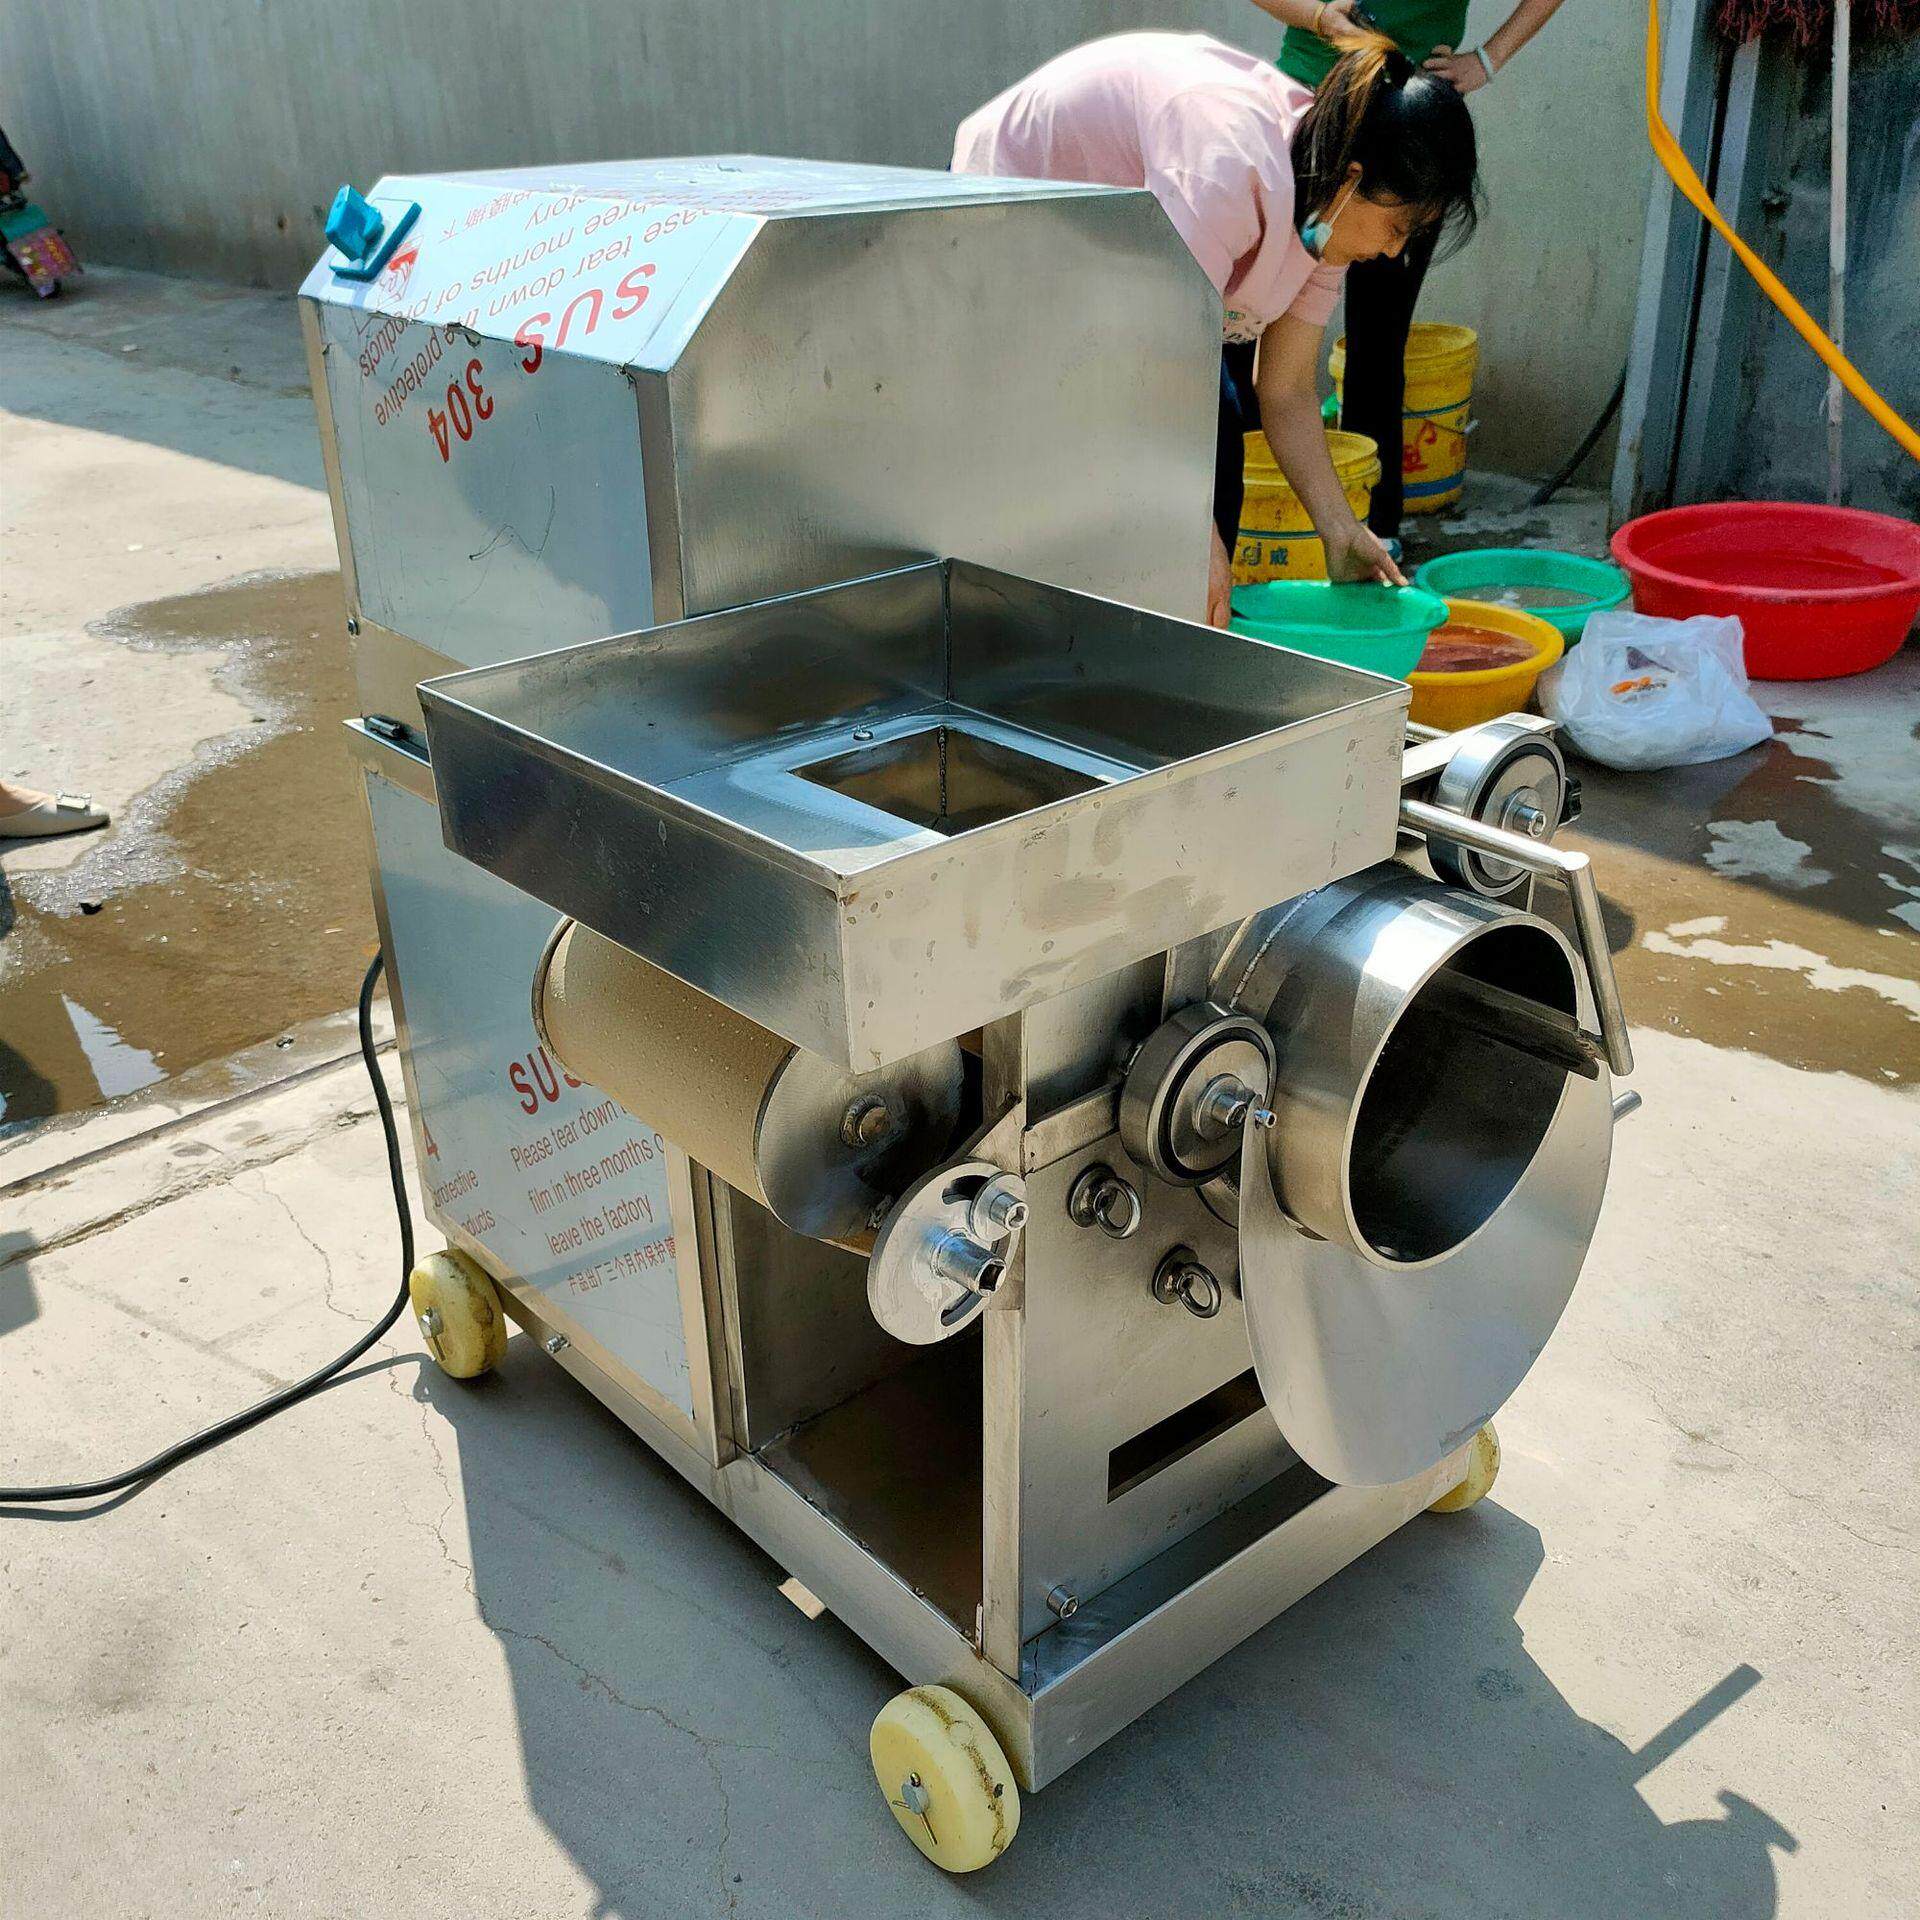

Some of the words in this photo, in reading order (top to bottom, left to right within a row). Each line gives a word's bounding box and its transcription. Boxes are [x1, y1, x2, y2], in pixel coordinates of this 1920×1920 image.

[525, 194, 587, 230] tory
[643, 208, 710, 243] ase
[471, 226, 574, 290] months
[572, 235, 632, 278] tear
[434, 282, 461, 314] of
[489, 267, 565, 317] down
[514, 263, 656, 374] SUS
[374, 326, 443, 426] protective
[427, 358, 494, 463] 304
[509, 1046, 582, 1115] SU
[510, 1138, 553, 1172] Please
[551, 1122, 580, 1150] tear
[579, 1100, 619, 1136] down
[527, 1189, 552, 1215] film
[551, 1182, 569, 1207] in
[565, 1163, 601, 1196] three
[602, 1138, 654, 1179] months
[460, 1207, 497, 1237] ducts
[545, 1221, 583, 1256] leave
[581, 1209, 605, 1239] the
[604, 1194, 655, 1232] factory
